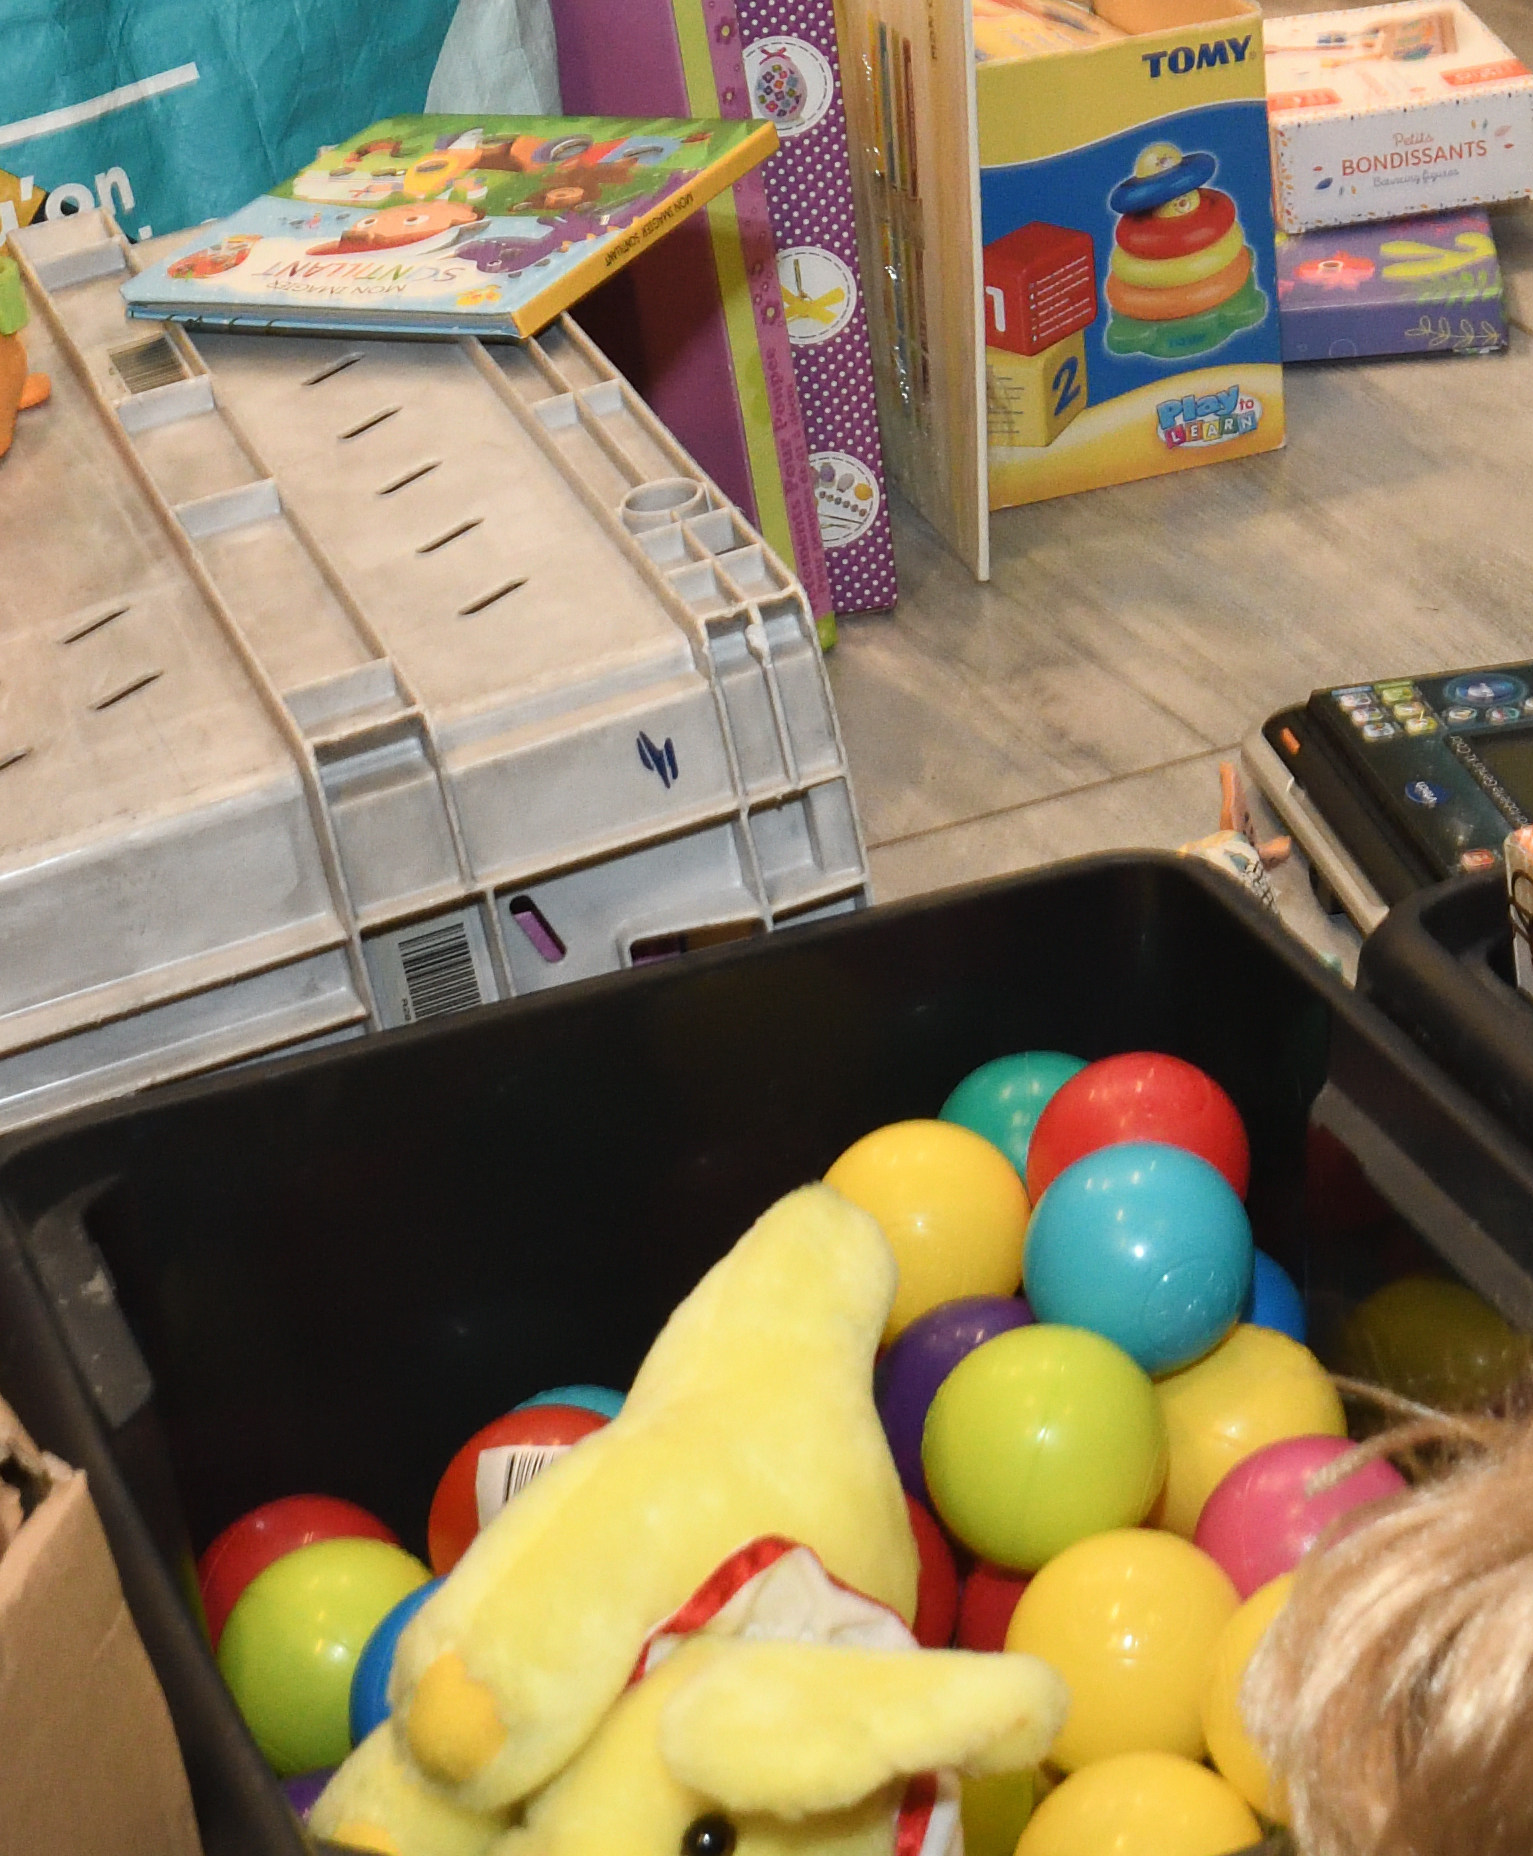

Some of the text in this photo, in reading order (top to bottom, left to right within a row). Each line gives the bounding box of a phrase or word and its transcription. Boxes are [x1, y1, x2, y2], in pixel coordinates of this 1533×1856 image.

[1142, 35, 1252, 78] TOMY
[1392, 132, 1434, 147] Petits
[1341, 140, 1488, 176] BONDISSANTS
[265, 280, 407, 295] MON IMAGIER
[1052, 356, 1081, 416] 2
[1156, 384, 1254, 430] Play to
[1170, 415, 1254, 445] LEARN
